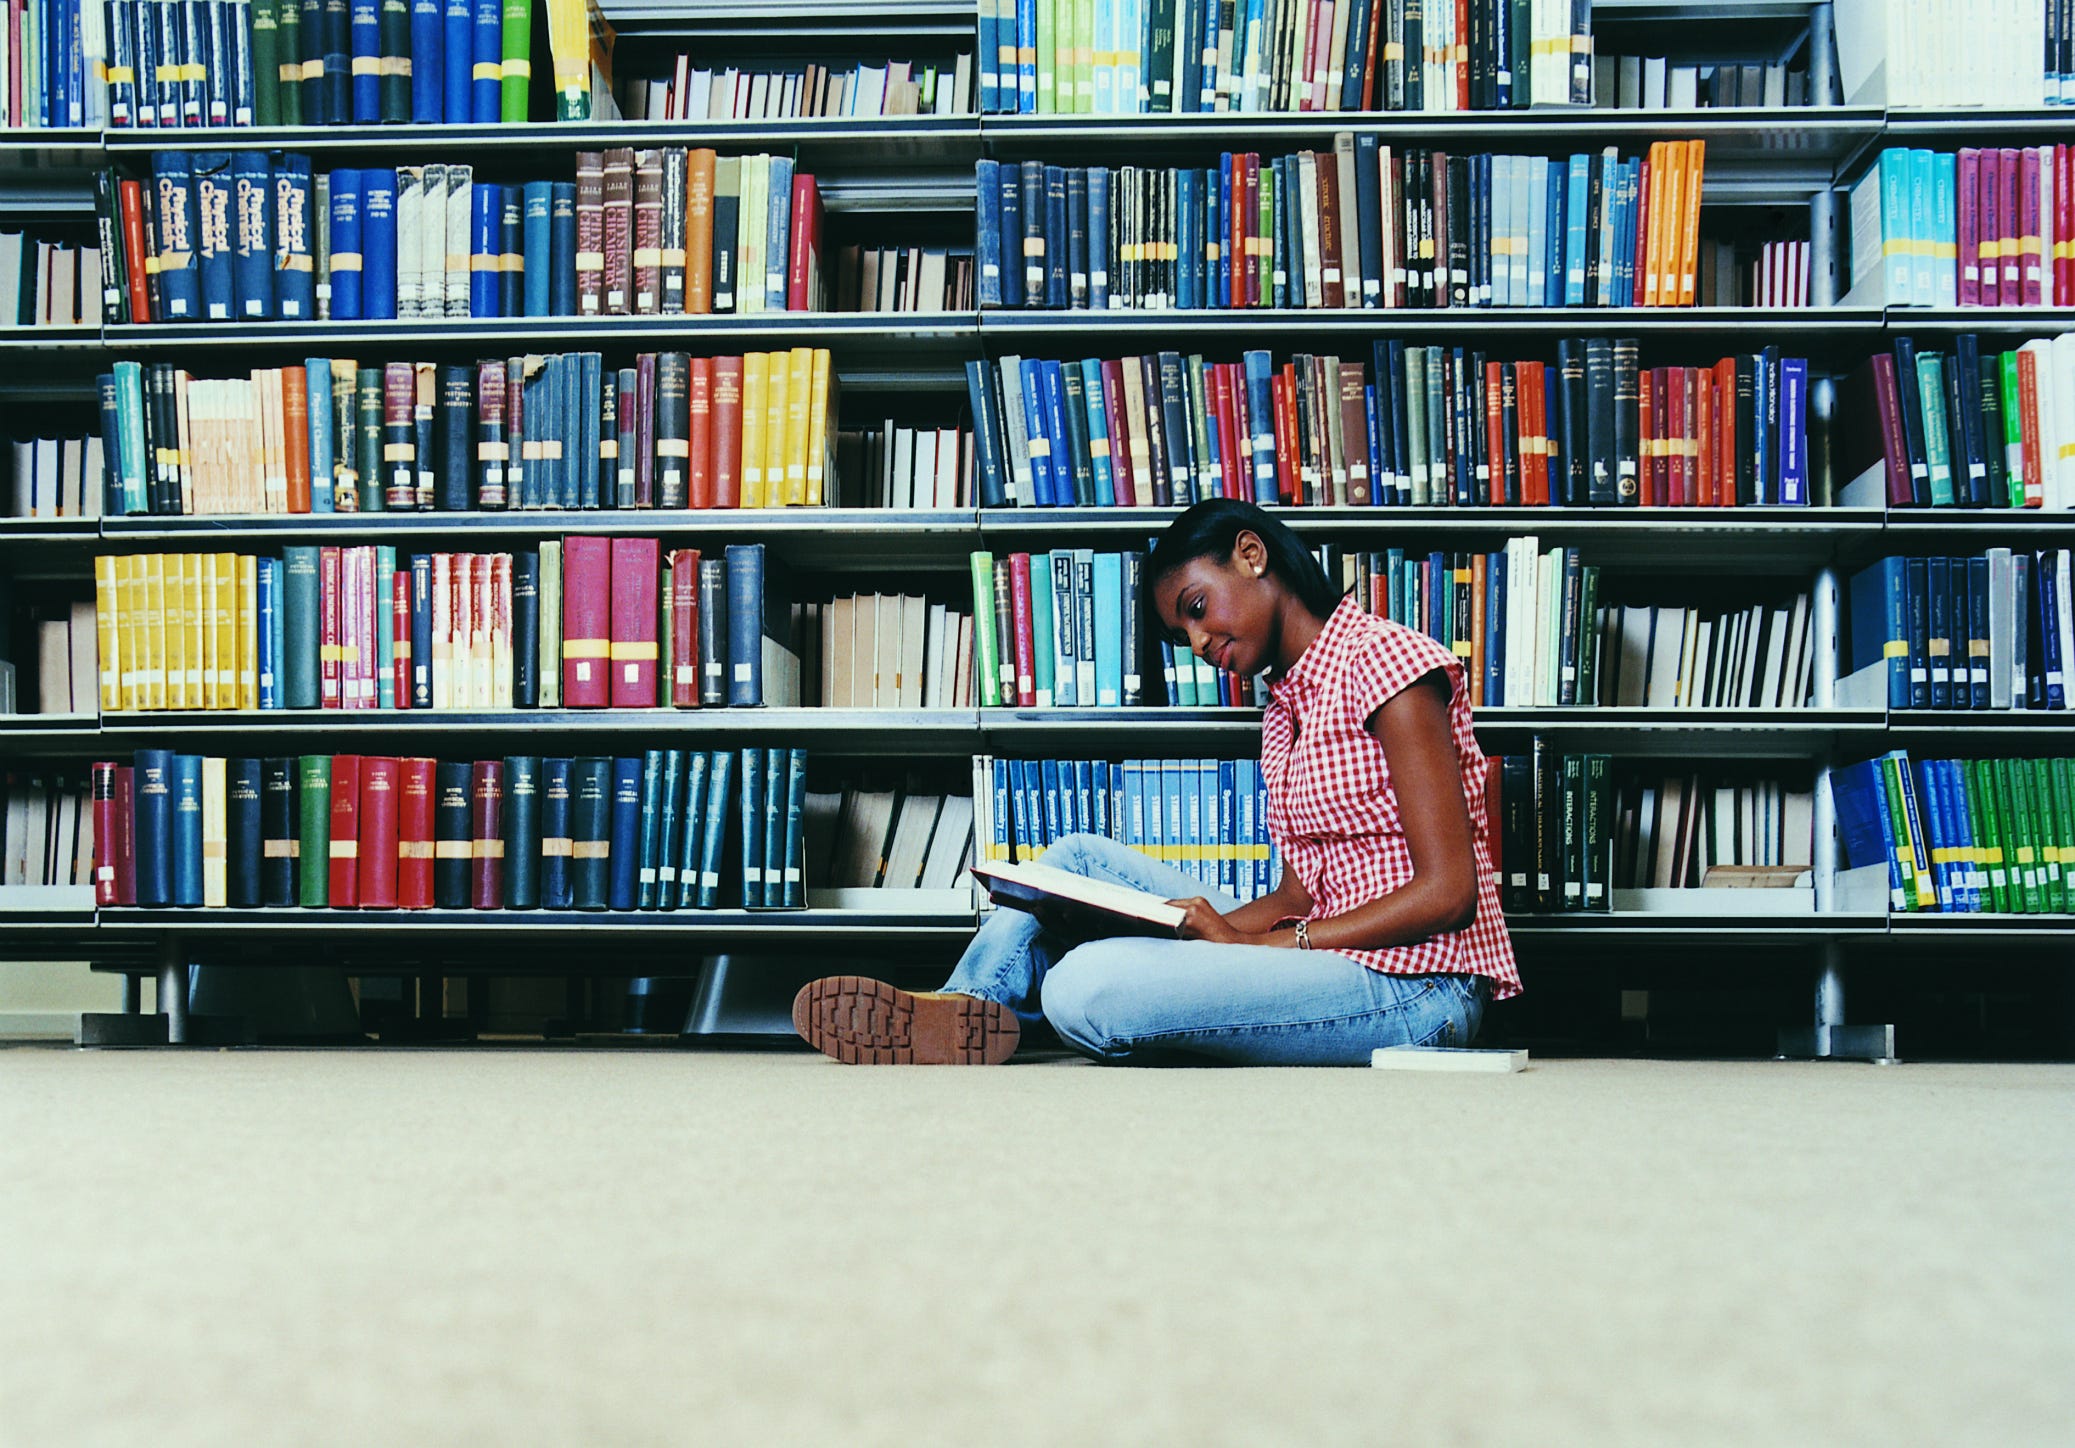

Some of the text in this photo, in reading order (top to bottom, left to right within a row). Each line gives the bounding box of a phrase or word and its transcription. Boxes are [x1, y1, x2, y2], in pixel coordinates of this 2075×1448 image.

[173, 187, 190, 250] Physical
[200, 180, 214, 259] Chemistry
[211, 189, 230, 252] Physical
[238, 178, 251, 258] Chemistry
[250, 187, 266, 250] Physical
[276, 178, 291, 256] Chemistry
[290, 188, 306, 252] Physical
[616, 207, 628, 285] PHYSICAL
[579, 211, 591, 288] CHEMRY
[590, 213, 602, 288] PHYSAL
[605, 207, 617, 286] CHEMISTRY
[636, 209, 647, 287] CHEMTRY
[648, 209, 659, 286] PHYSAL
[311, 392, 323, 472] Physical Chemistry
[996, 788, 1006, 830] Symmetry
[1013, 789, 1025, 831] Symmetry
[1030, 789, 1040, 831] Symmetry
[1047, 789, 1058, 831] Symmetry
[1062, 789, 1073, 831] Symmetry
[1080, 789, 1090, 831] Symmetry
[1096, 788, 1107, 830] Symmetry
[1113, 789, 1123, 831] Symmetry
[1221, 789, 1231, 831] Symmetry
[1257, 789, 1267, 831] Symmetry
[1565, 791, 1574, 845] INTERACTIONS
[1588, 791, 1597, 845] INTERACTIONS
[1881, 805, 1892, 842] Chemistry
[1931, 807, 1942, 844] Chemistry
